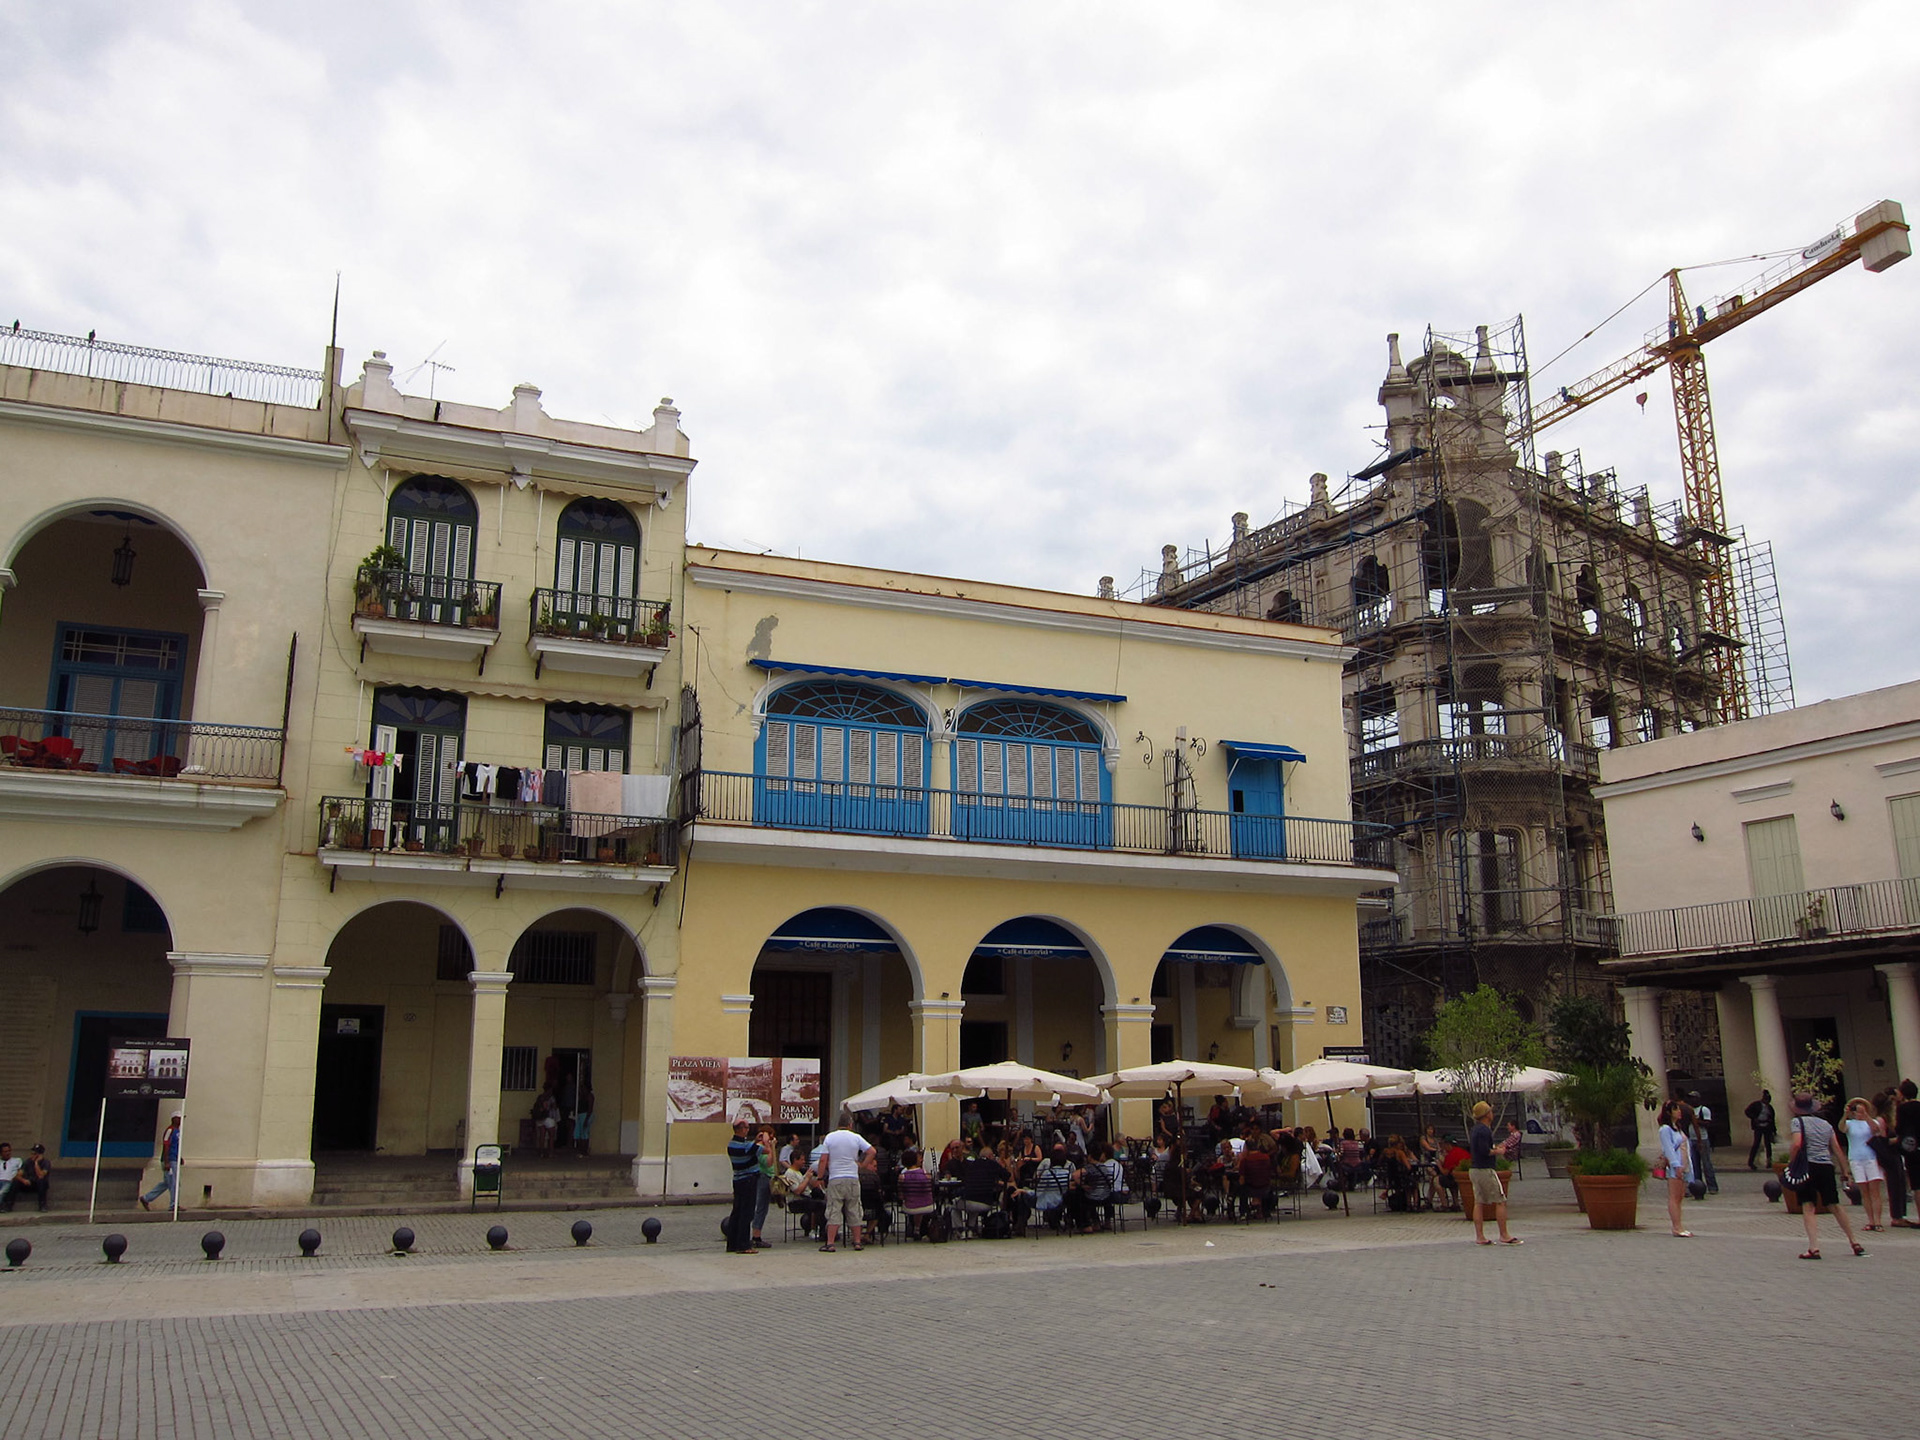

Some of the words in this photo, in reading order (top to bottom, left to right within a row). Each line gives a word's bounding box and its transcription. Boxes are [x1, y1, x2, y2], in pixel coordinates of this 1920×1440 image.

[827, 941, 854, 949] Escorial
[672, 1059, 698, 1068] PLAZA
[700, 1060, 720, 1068] VIEJA
[780, 1105, 800, 1113] PARA
[801, 1105, 814, 1113] NO
[780, 1112, 814, 1120] OLVIDAR
